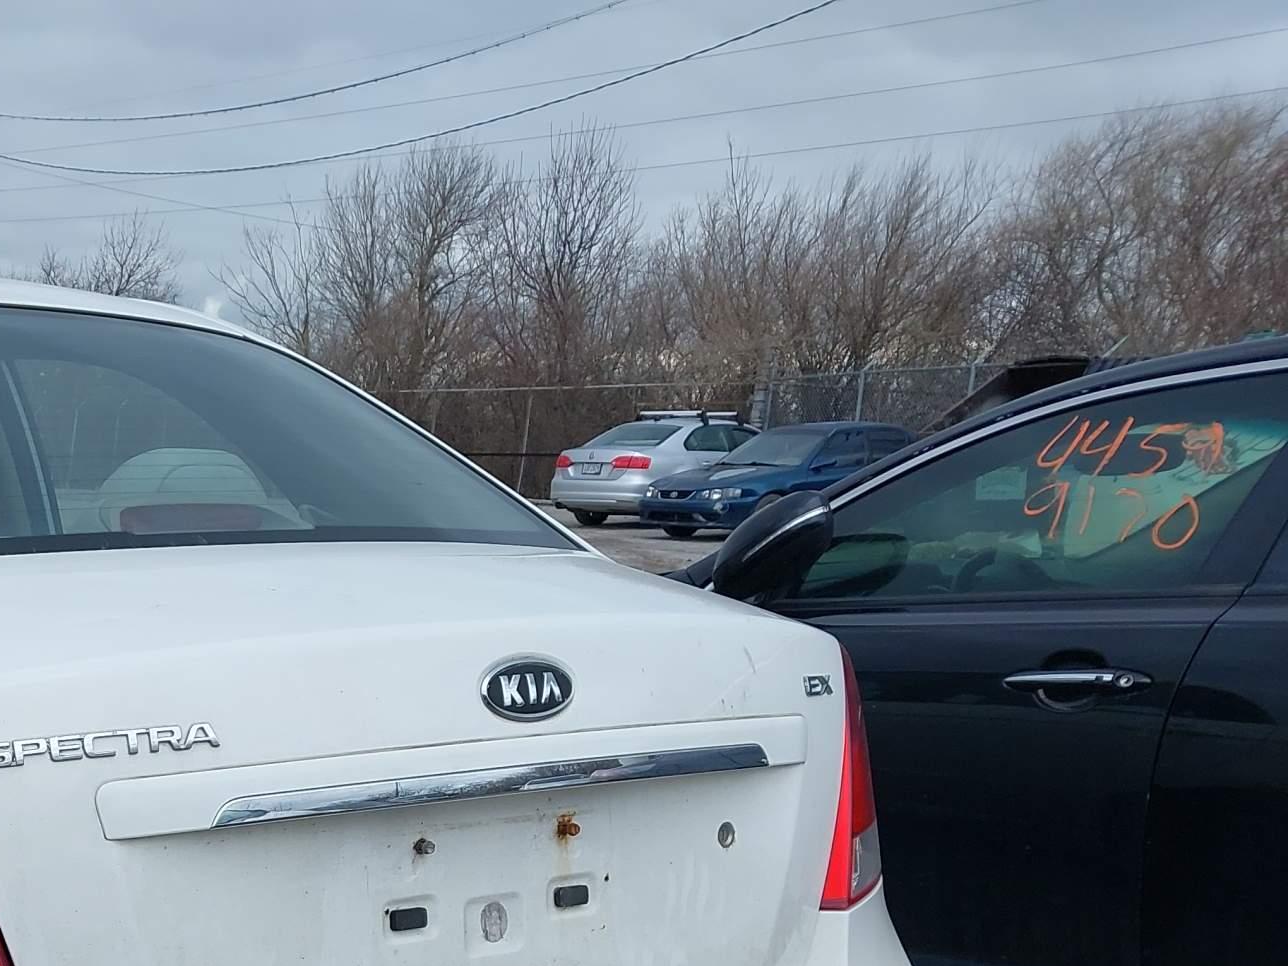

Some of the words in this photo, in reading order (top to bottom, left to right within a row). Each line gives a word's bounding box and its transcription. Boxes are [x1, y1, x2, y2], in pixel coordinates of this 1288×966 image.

[1024, 481, 1200, 550] 9170
[498, 671, 563, 707] KIA
[803, 674, 833, 697] EX
